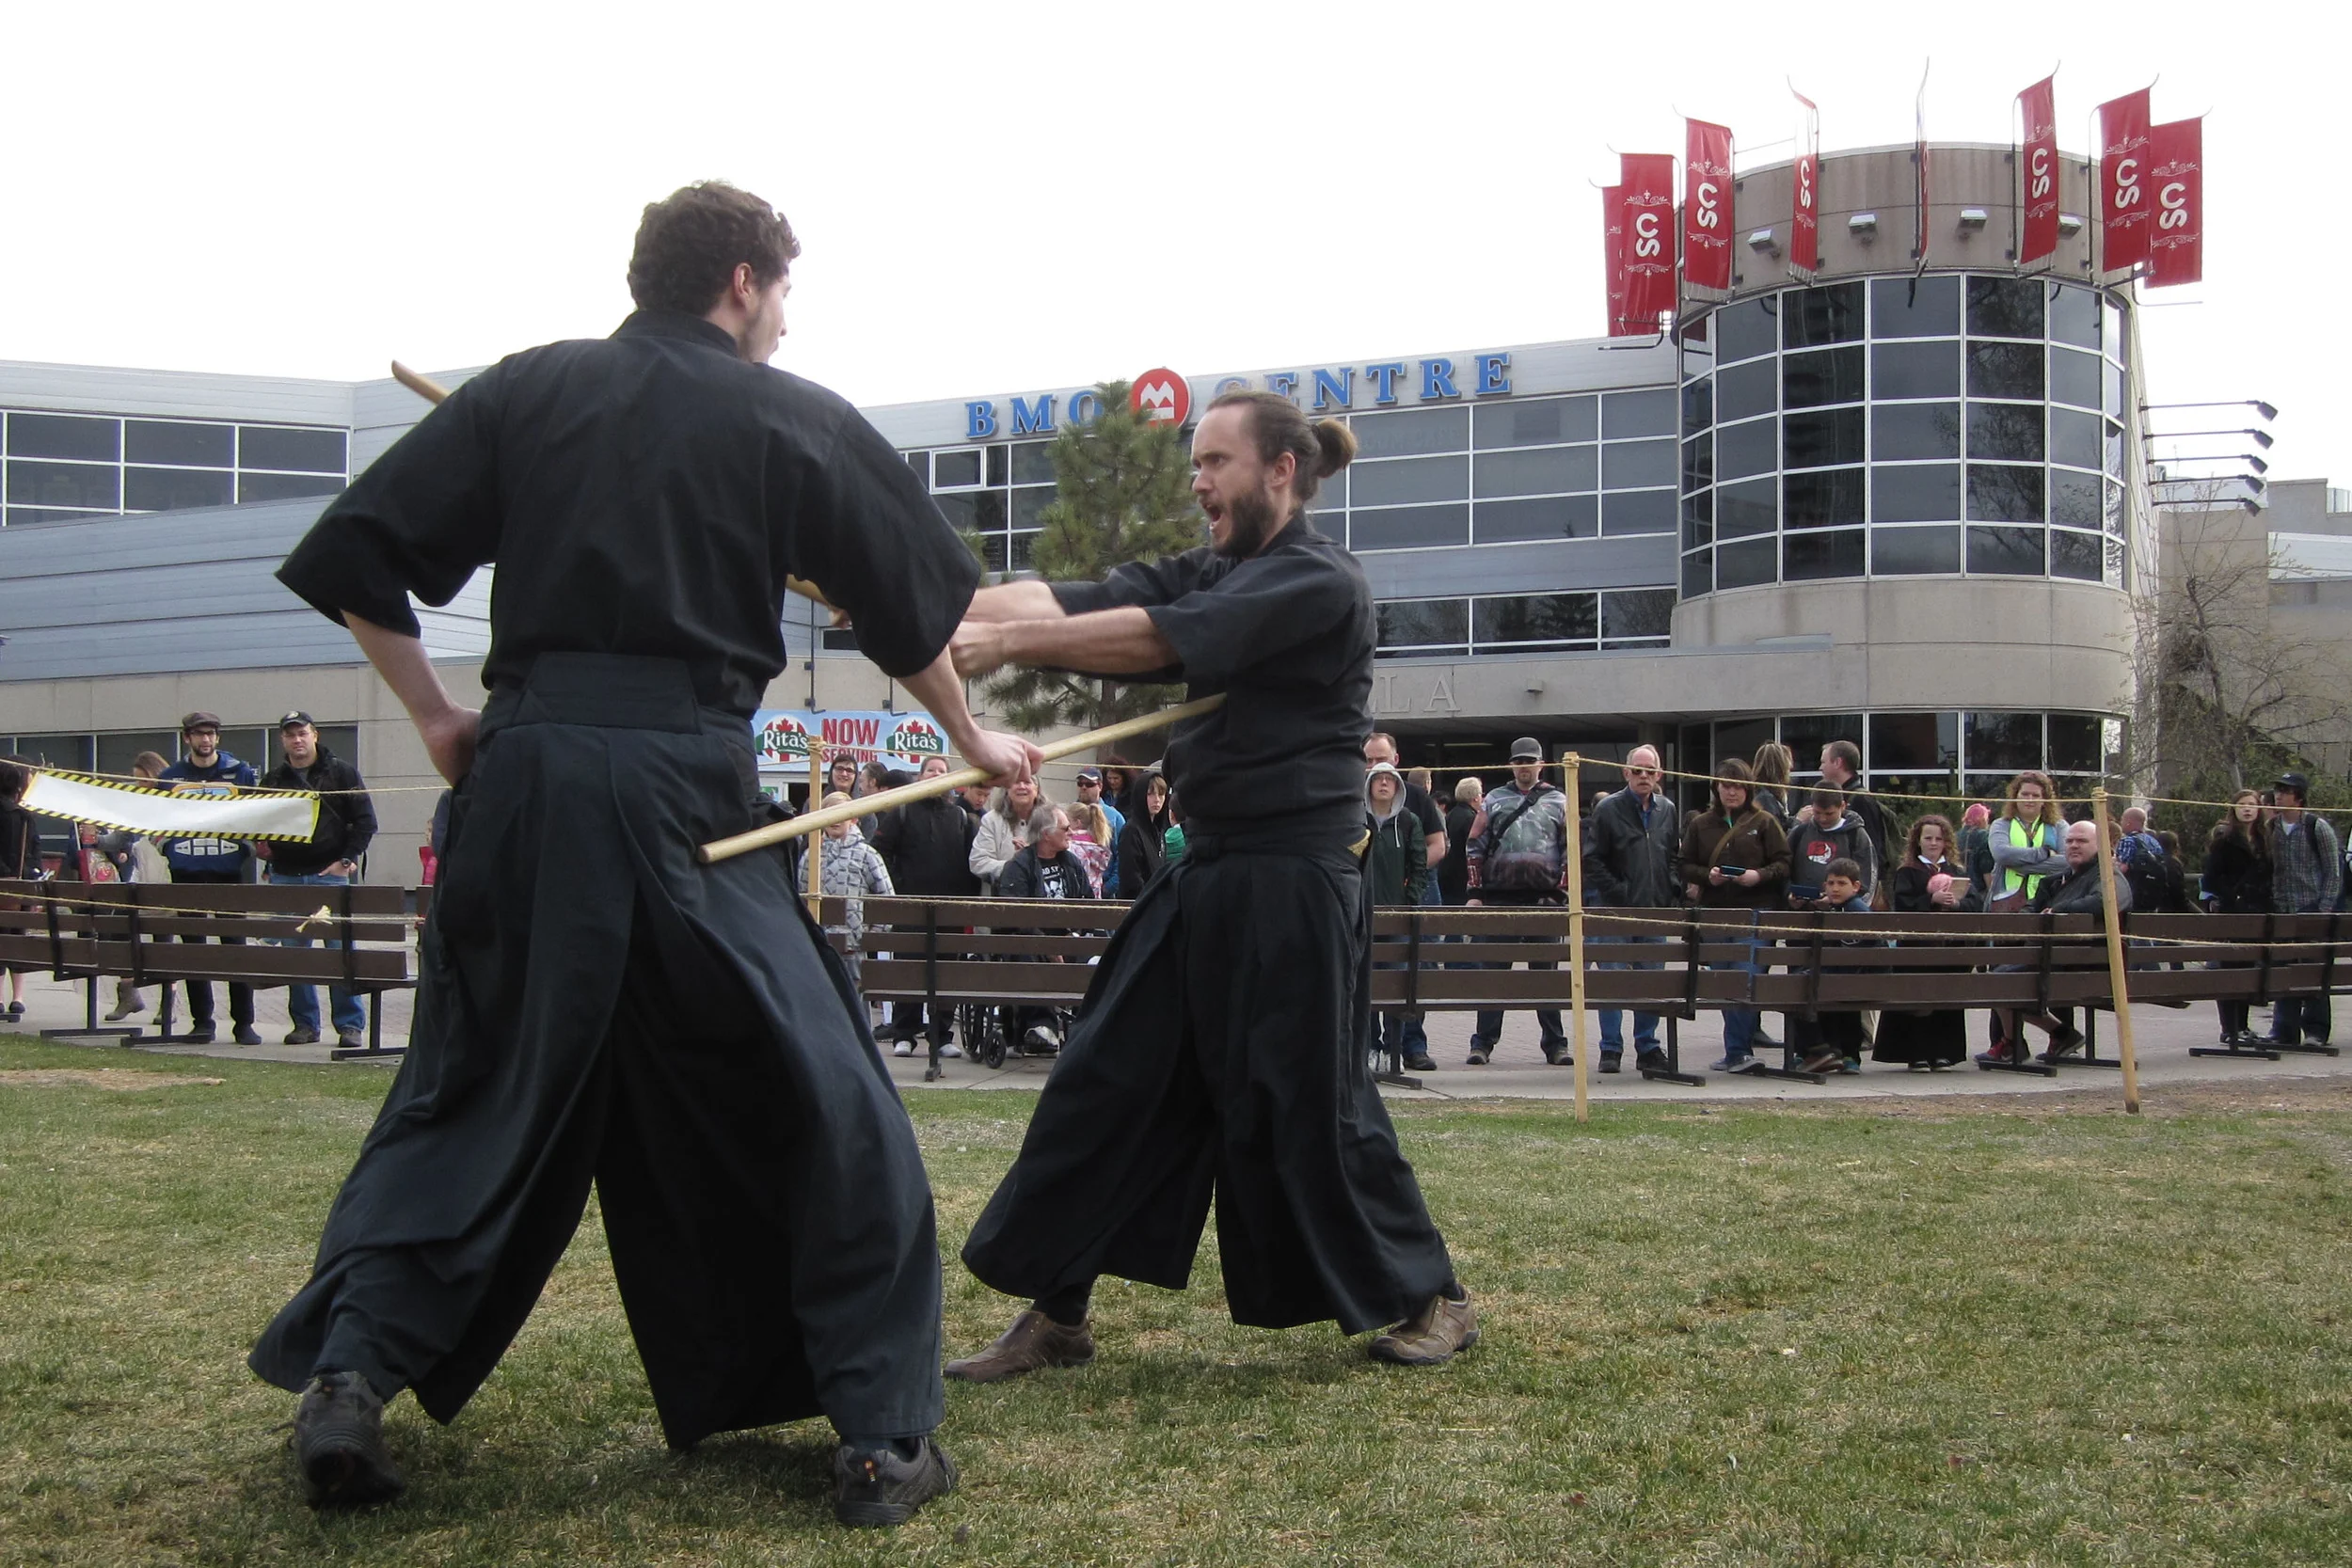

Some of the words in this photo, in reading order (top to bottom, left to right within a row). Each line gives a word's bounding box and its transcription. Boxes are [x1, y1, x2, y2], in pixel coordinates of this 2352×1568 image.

[2031, 147, 2051, 199] CS
[2114, 158, 2140, 209] CS
[1696, 182, 1718, 230] CS
[2158, 182, 2187, 230] CS
[1635, 212, 1661, 258] CS
[964, 389, 1104, 439] BMO
[1370, 672, 1461, 714] LA
[763, 730, 808, 751] Rita's
[821, 718, 881, 746] NOW
[894, 731, 938, 751] Rita's
